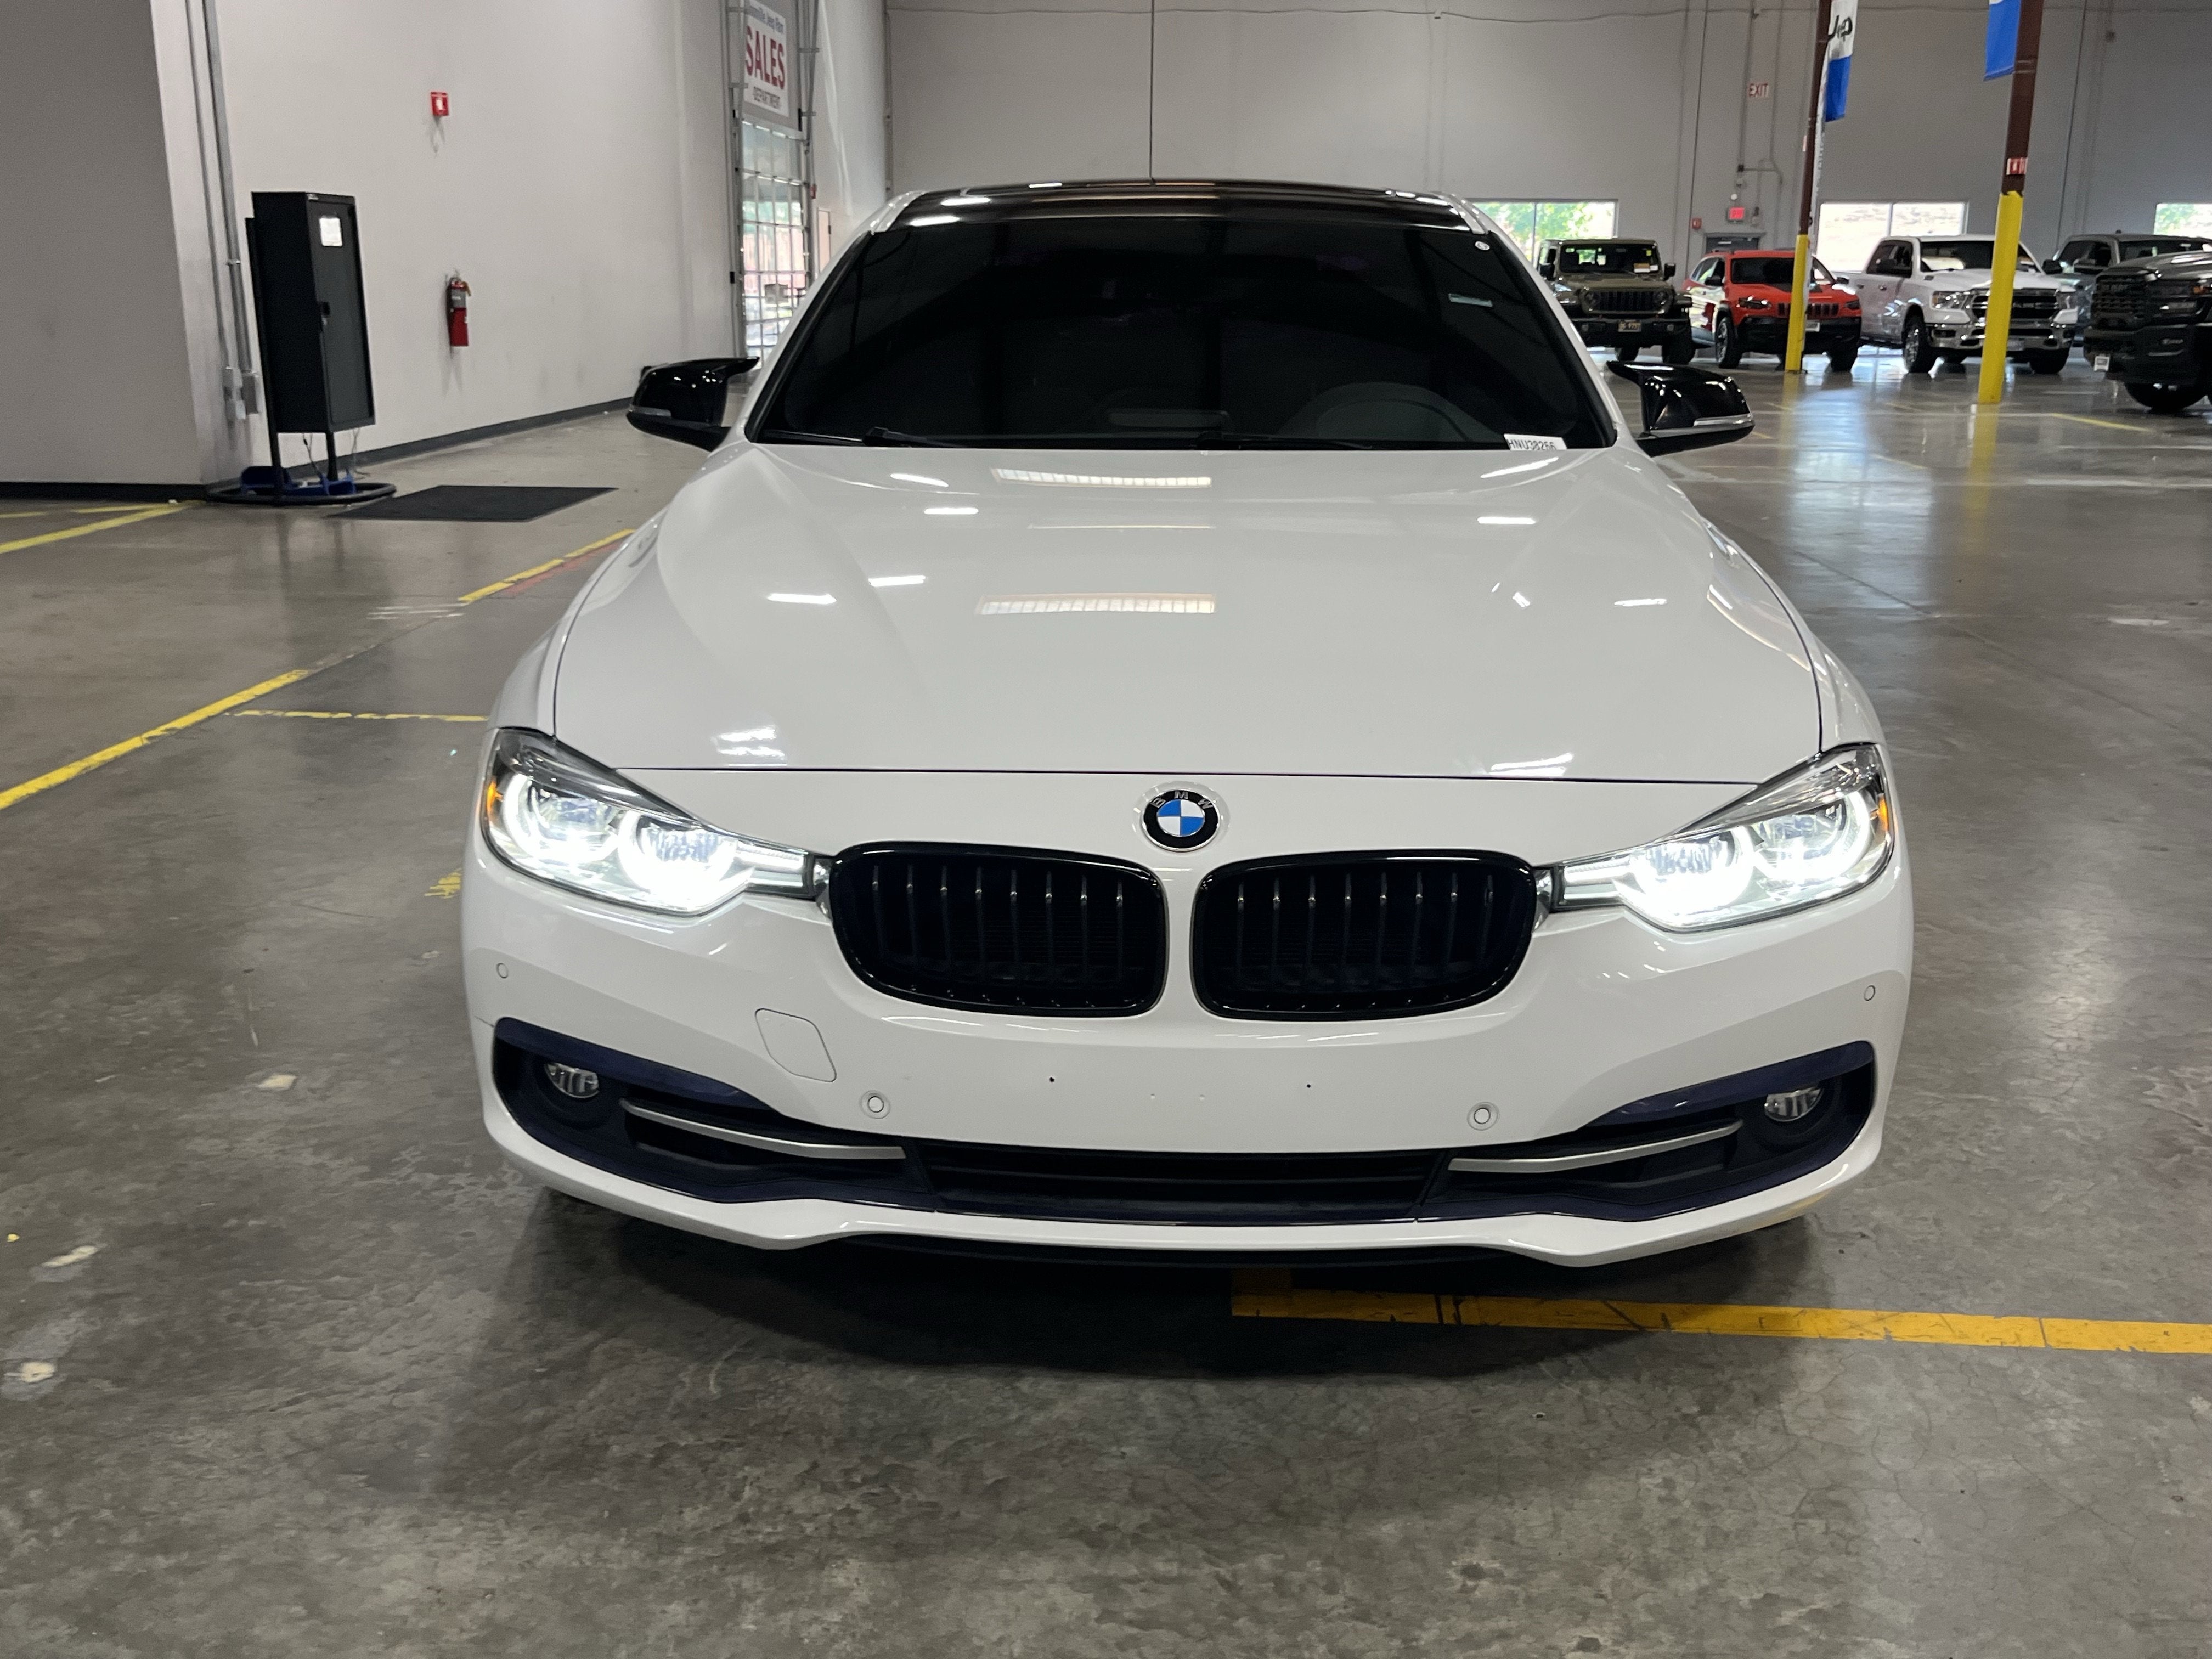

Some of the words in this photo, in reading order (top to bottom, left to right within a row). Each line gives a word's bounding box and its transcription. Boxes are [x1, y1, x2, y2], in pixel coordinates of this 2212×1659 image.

[745, 25, 785, 90] SALES
[1748, 83, 1769, 97] EXIT
[1150, 791, 1214, 810] BMW
